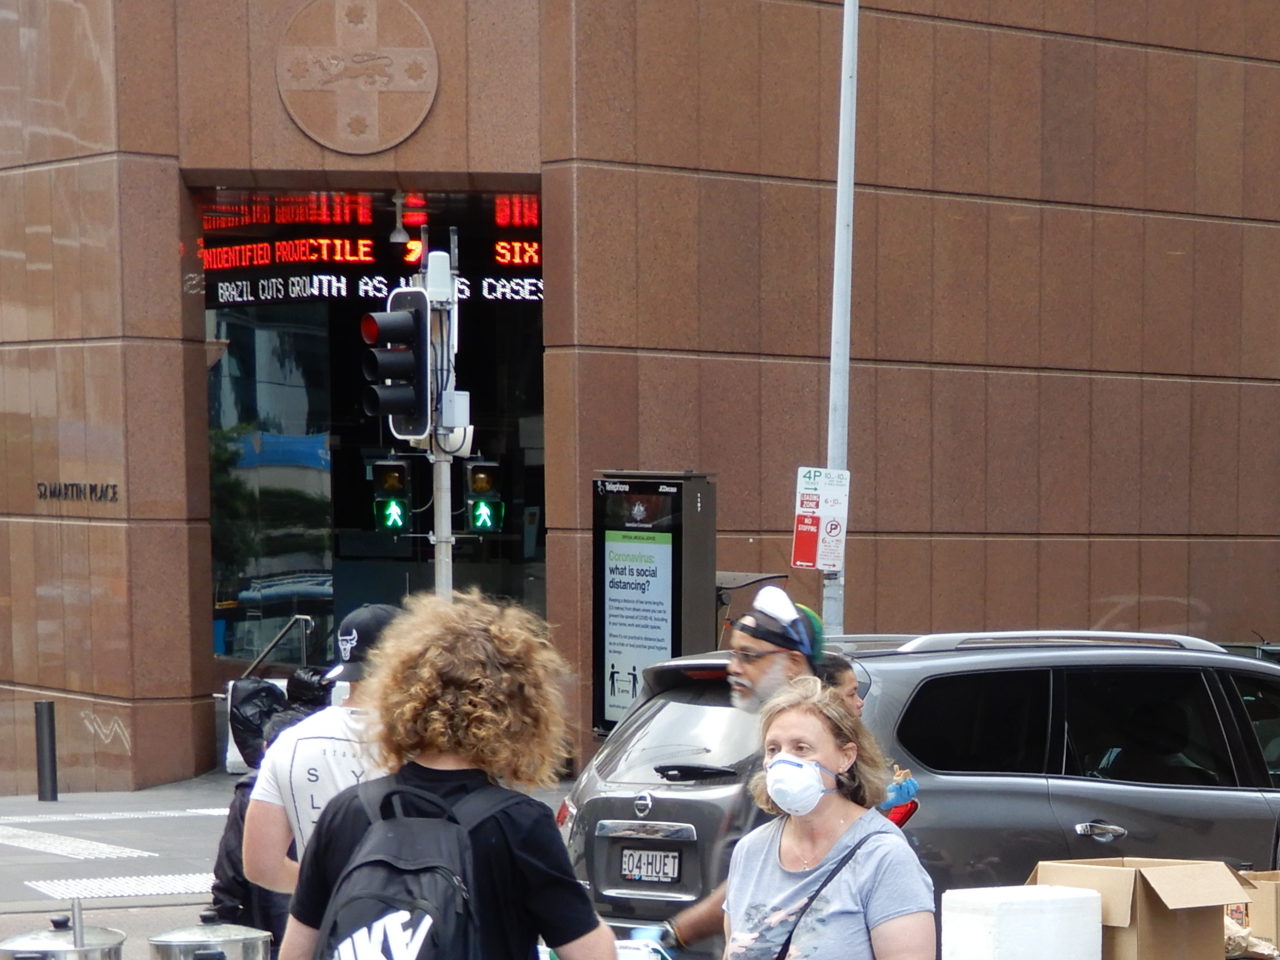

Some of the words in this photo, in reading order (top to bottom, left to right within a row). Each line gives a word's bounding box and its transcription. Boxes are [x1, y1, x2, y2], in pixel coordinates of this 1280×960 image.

[495, 241, 539, 265] SIX
[217, 282, 254, 303] BRAZIL
[258, 277, 284, 300] CUTS
[288, 274, 347, 299] GROWTH
[358, 275, 388, 298] AS
[802, 470, 822, 481] 4P
[49, 482, 87, 501] MARTIN
[89, 483, 119, 502] PLACE
[605, 482, 630, 493] Telephone
[608, 550, 656, 565] Coronavirus:
[608, 564, 627, 577] what
[628, 565, 635, 578] is
[635, 566, 658, 579] social
[608, 578, 651, 595] distancing?
